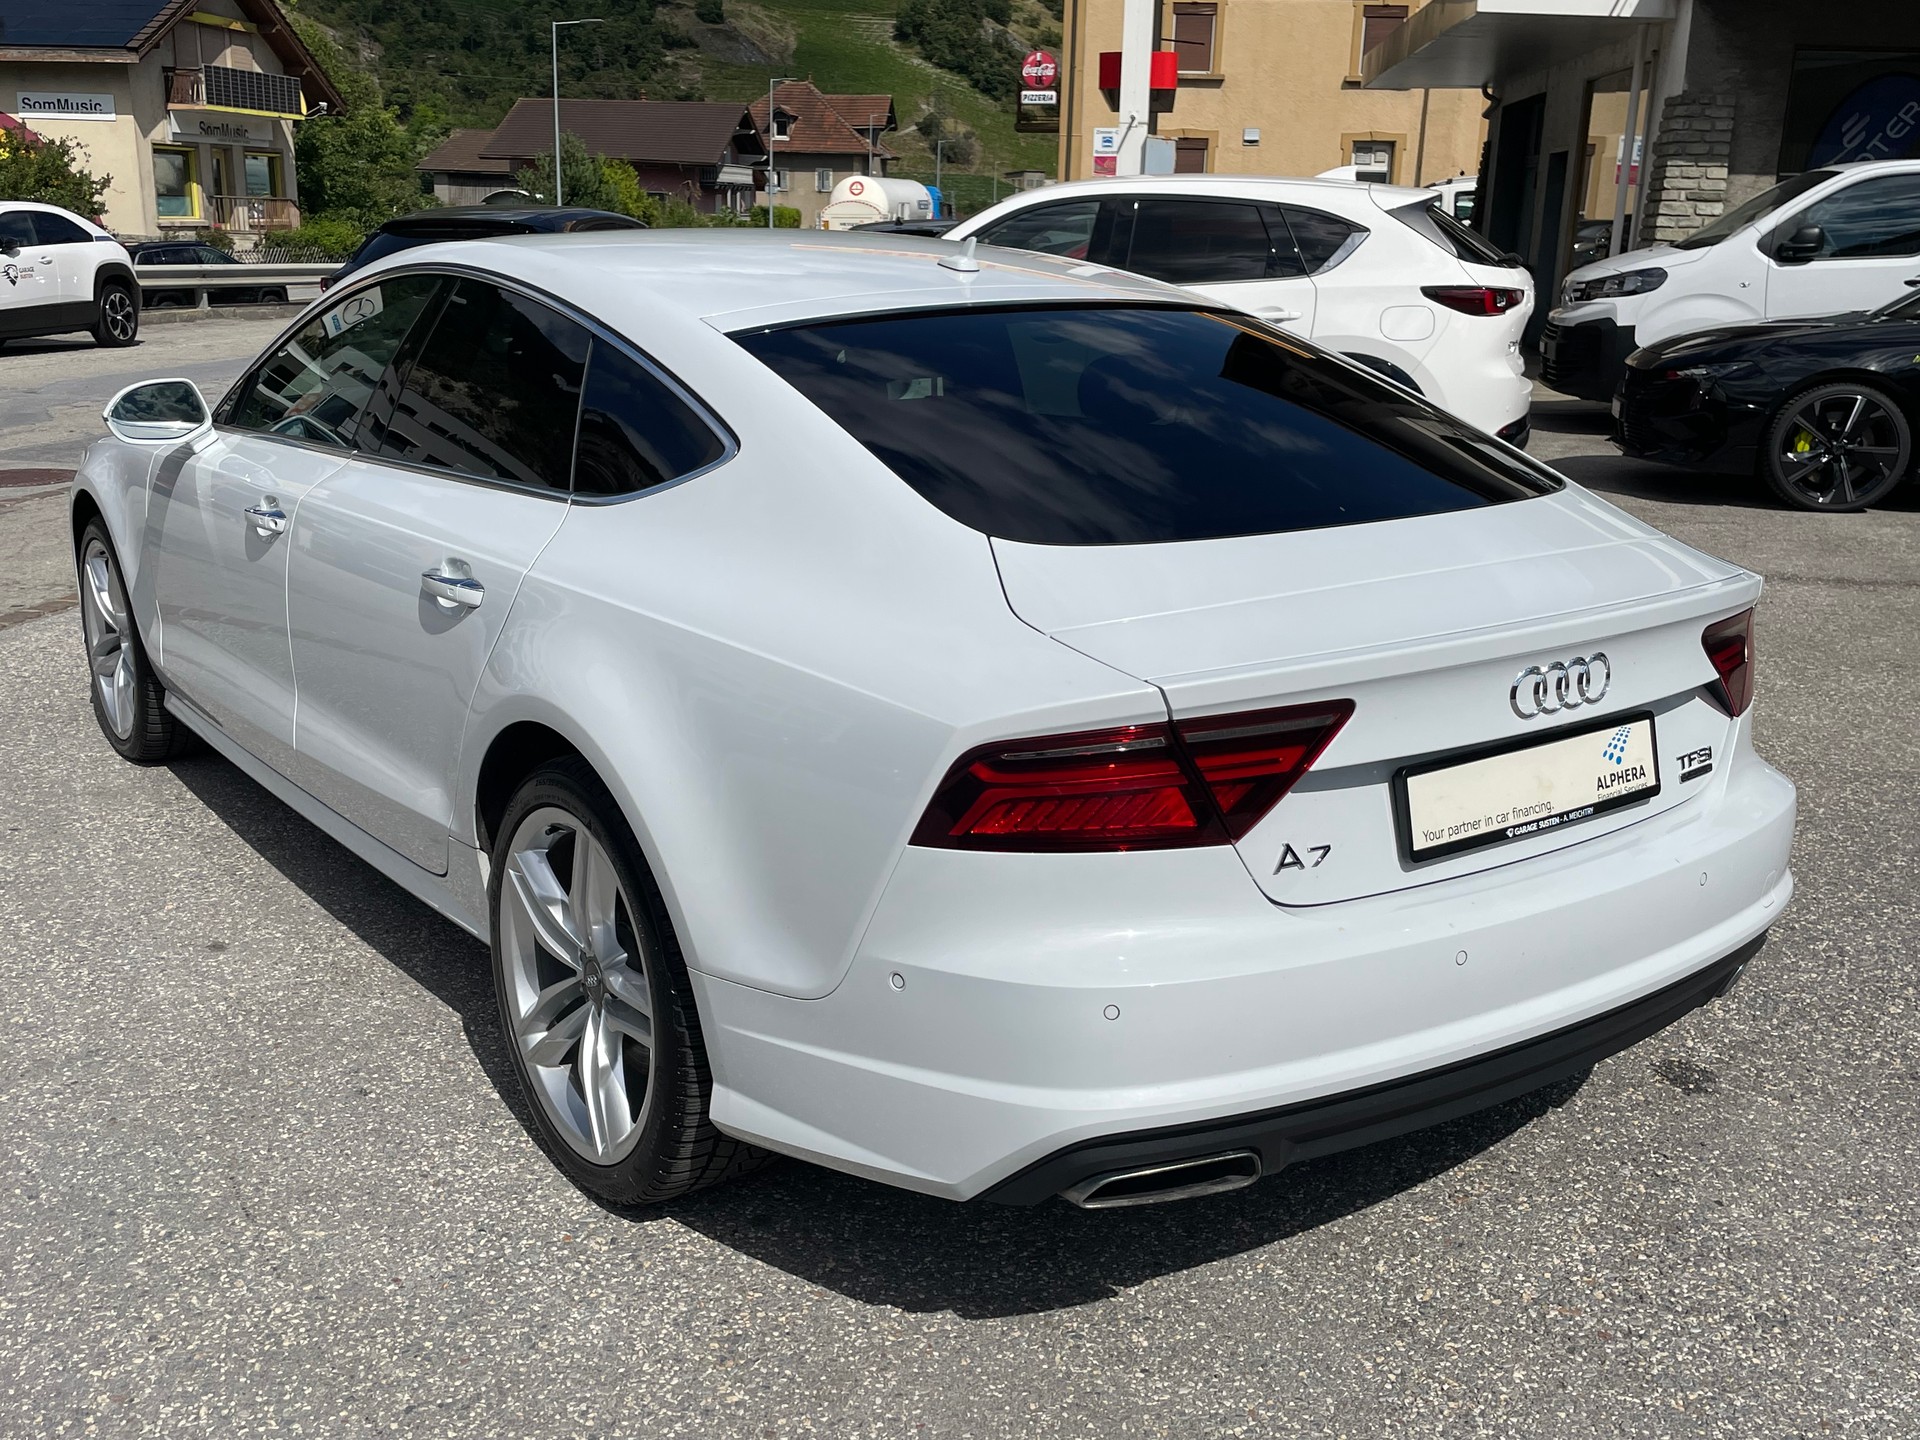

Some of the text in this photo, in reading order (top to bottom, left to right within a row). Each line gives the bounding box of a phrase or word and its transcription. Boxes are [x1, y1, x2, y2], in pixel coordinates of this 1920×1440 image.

[21, 97, 103, 112] SomMusic
[1022, 94, 1054, 102] PIZZERIA
[199, 121, 249, 139] SomMusic
[1676, 745, 1712, 771] TFSI
[1596, 764, 1647, 791] ALPHERA
[1597, 781, 1648, 801] Financial Services
[1422, 800, 1555, 843] Your partner in car financing.
[1514, 822, 1538, 836] GARAGE
[1538, 816, 1560, 829] SUSTEN
[1568, 806, 1594, 820] MEICHTRY
[1272, 843, 1332, 876] A7
